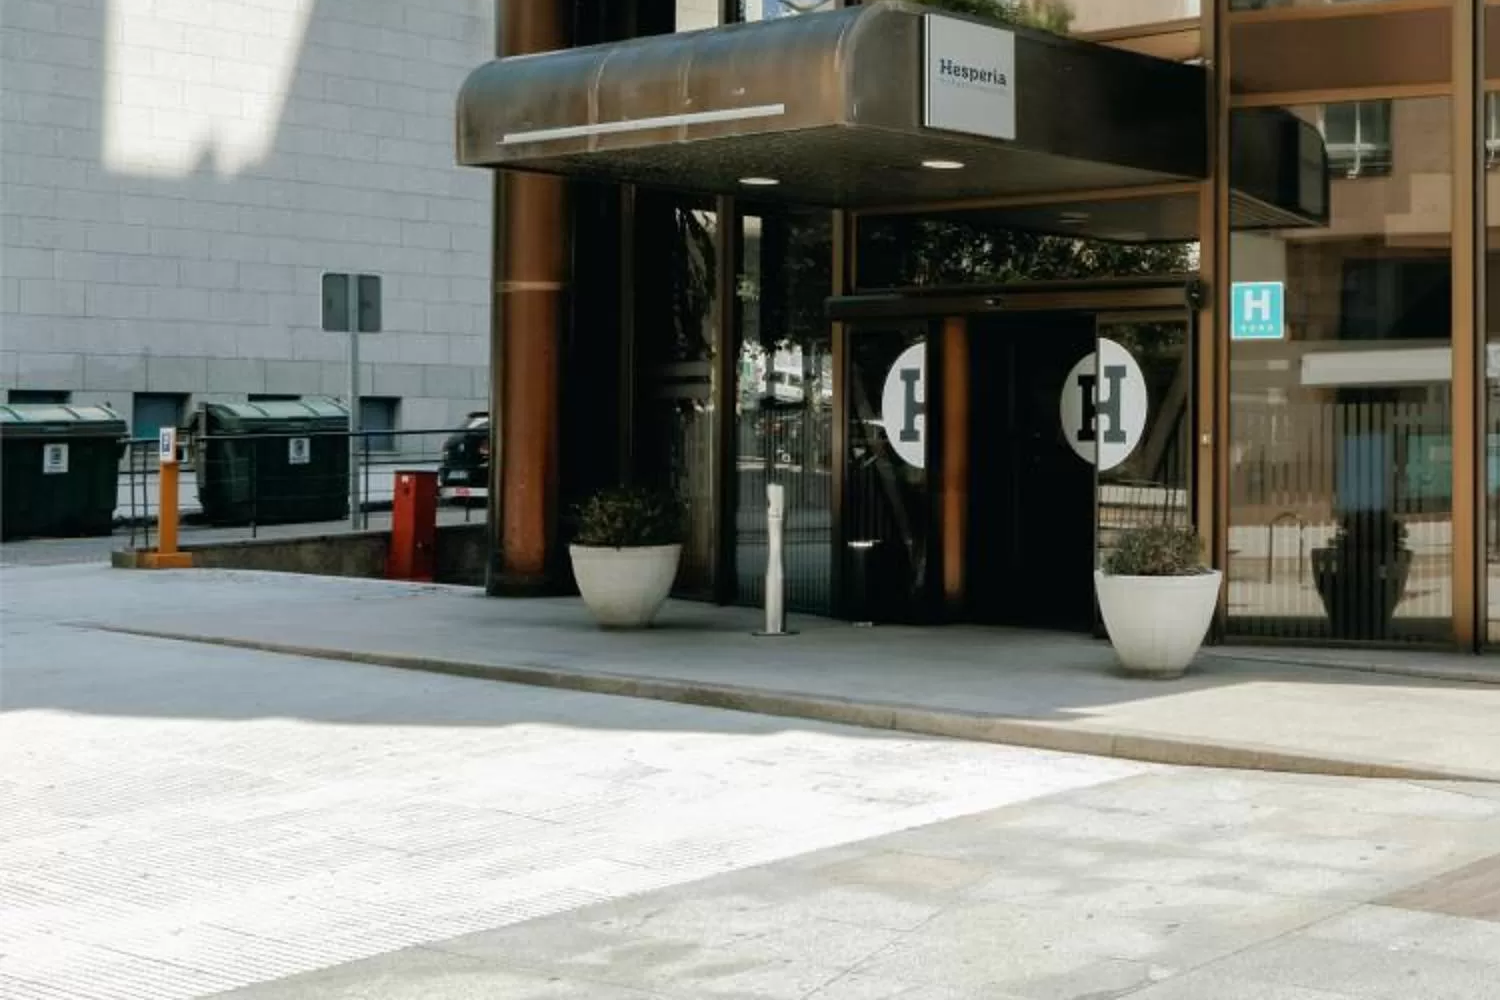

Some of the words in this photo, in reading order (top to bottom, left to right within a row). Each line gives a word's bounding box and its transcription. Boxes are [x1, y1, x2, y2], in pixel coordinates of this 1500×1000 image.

[940, 58, 1007, 87] Hesperia
[1243, 289, 1270, 321] H
[1077, 364, 1127, 443] H
